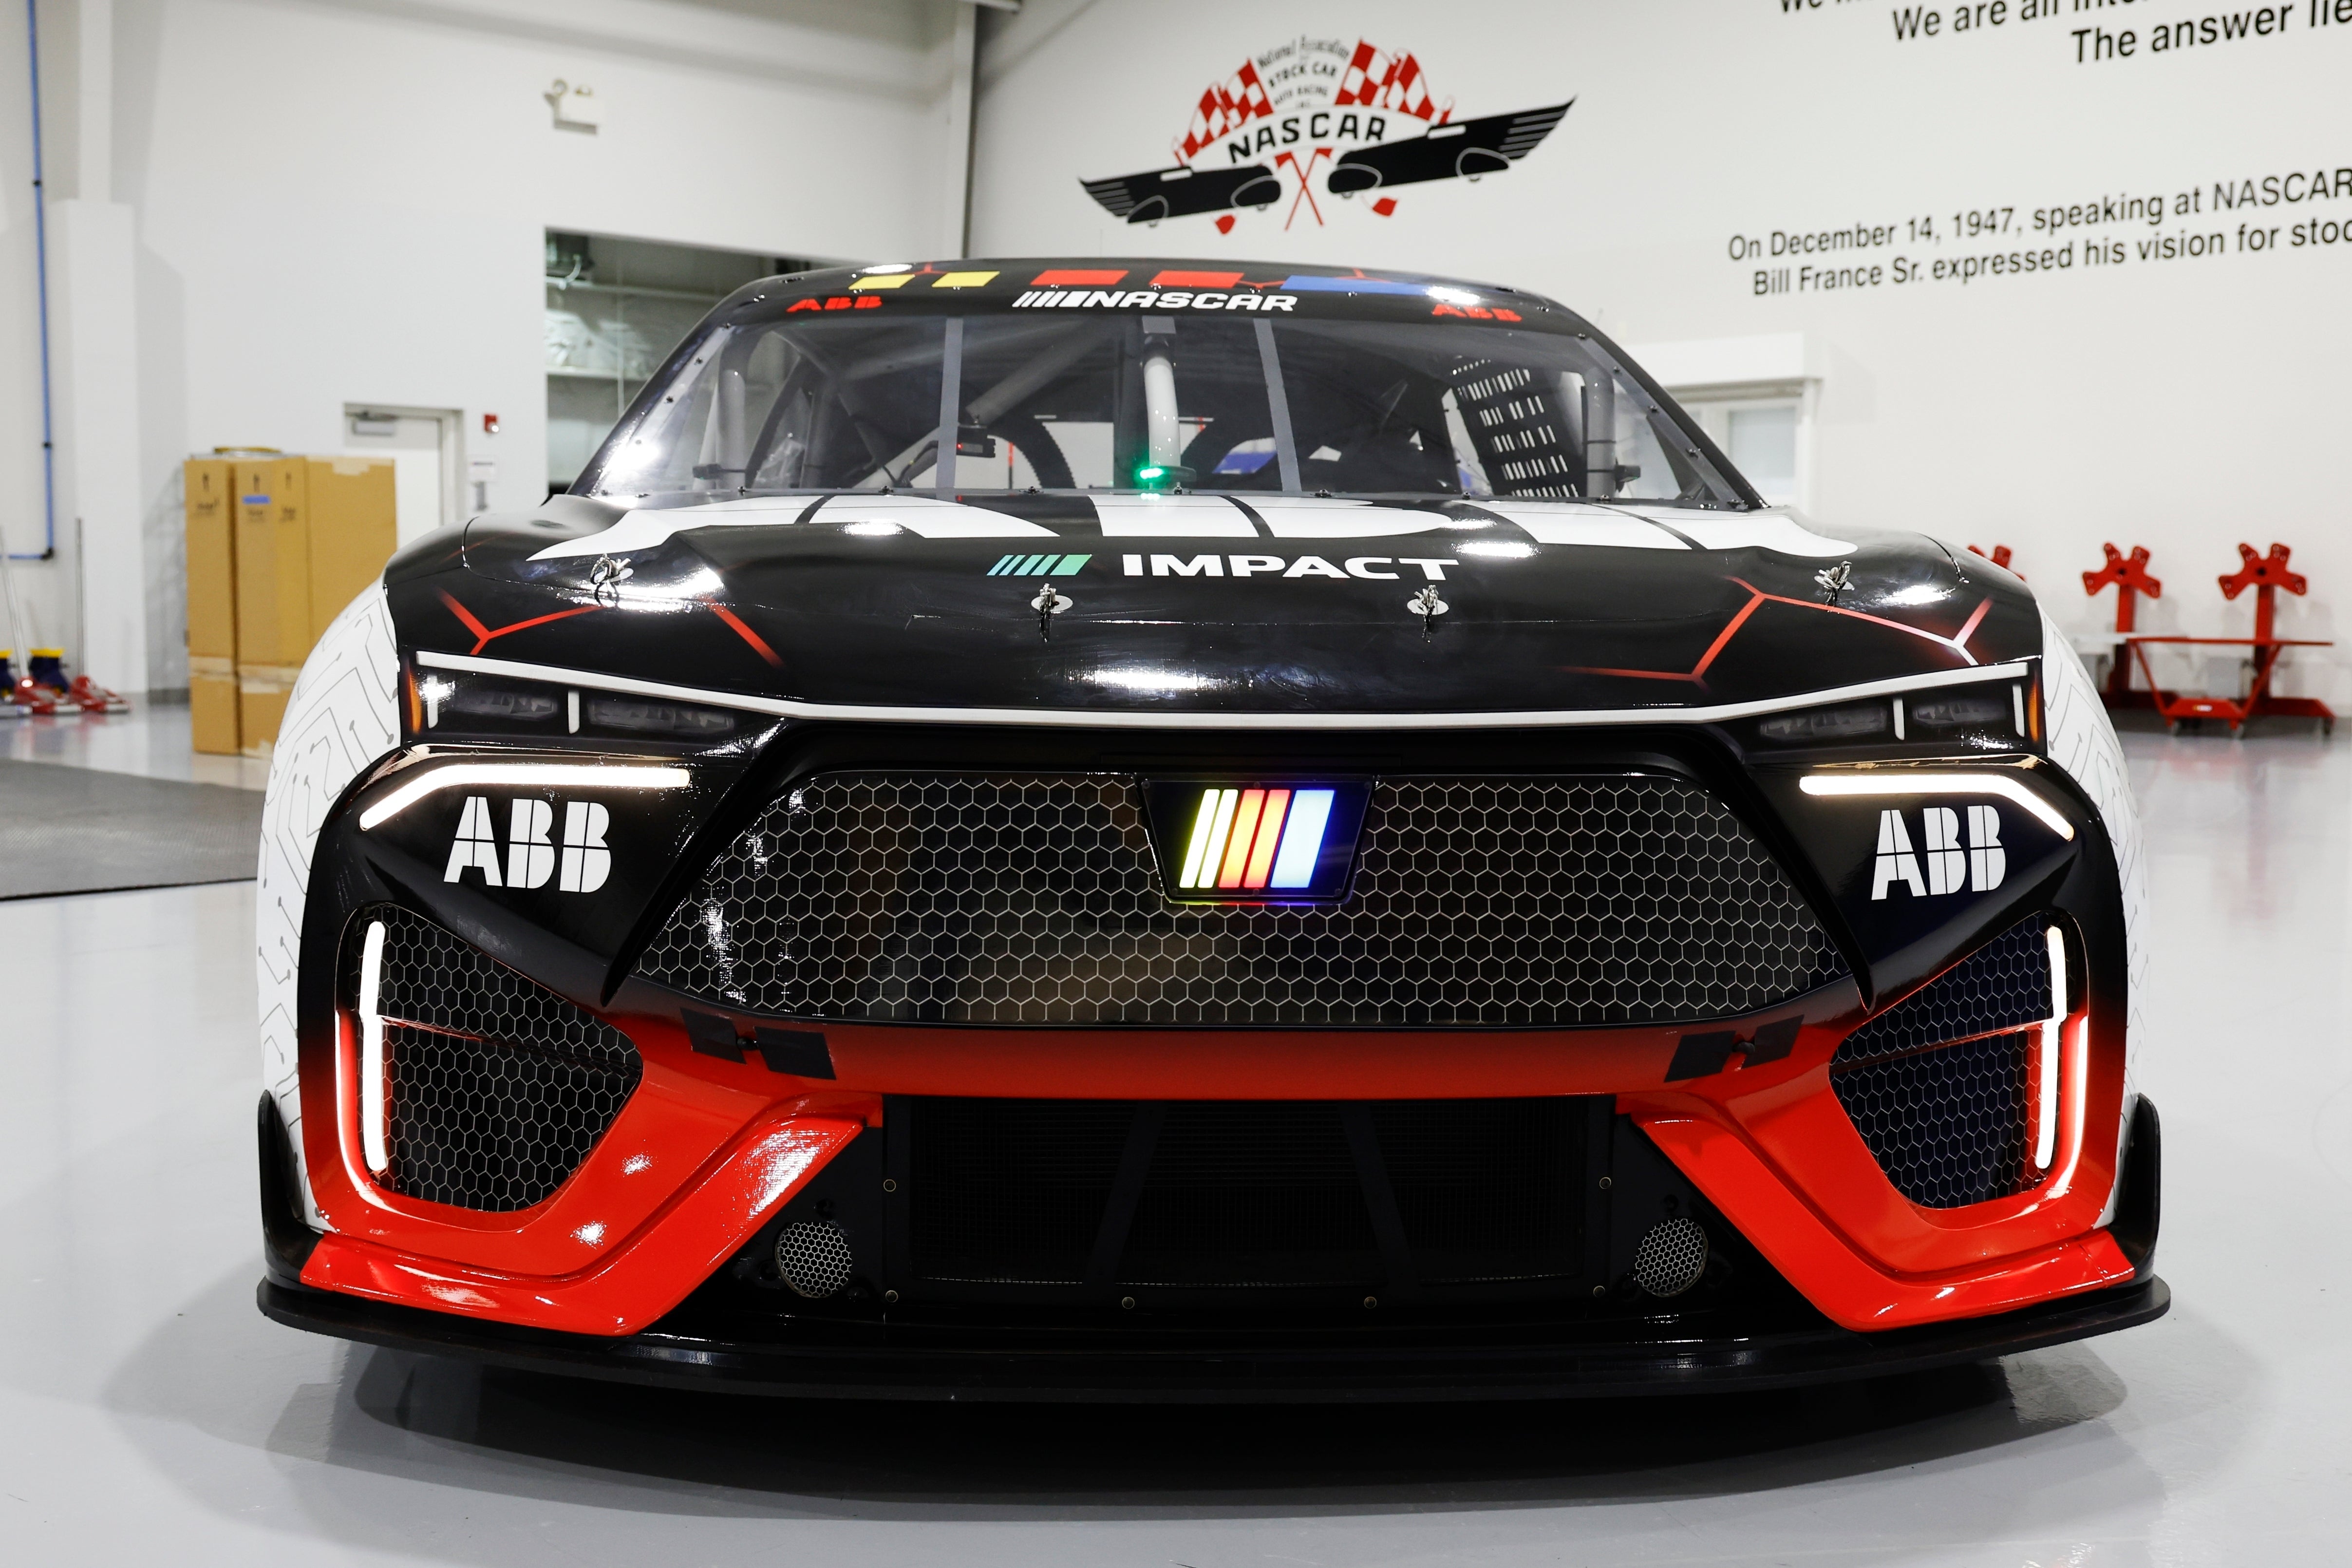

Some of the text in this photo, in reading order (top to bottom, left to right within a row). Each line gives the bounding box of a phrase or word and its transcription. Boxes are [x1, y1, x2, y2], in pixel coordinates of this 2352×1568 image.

[1893, 6, 1941, 40] We
[1954, 3, 2007, 32] are
[2070, 27, 2137, 63] The
[2151, 4, 2294, 53] answer
[1312, 61, 1337, 77] CAR
[1227, 112, 1386, 165] NASCAR
[1729, 168, 2352, 261] On December 14, 1947, speaking at NASCAR
[1754, 269, 1789, 296] Bill
[1800, 265, 1882, 291] France
[1893, 256, 1923, 283] Sr.
[1933, 242, 2072, 284] expressed
[2085, 238, 2126, 265] his
[2137, 230, 2224, 261] vision
[2238, 223, 2280, 252] for
[787, 296, 883, 312] ABB
[1082, 291, 1298, 311] NASCAR
[1432, 304, 1523, 322] ABB
[1122, 554, 1459, 581] IMPACT
[444, 796, 611, 893] ABB
[1871, 805, 2006, 900] ABB
